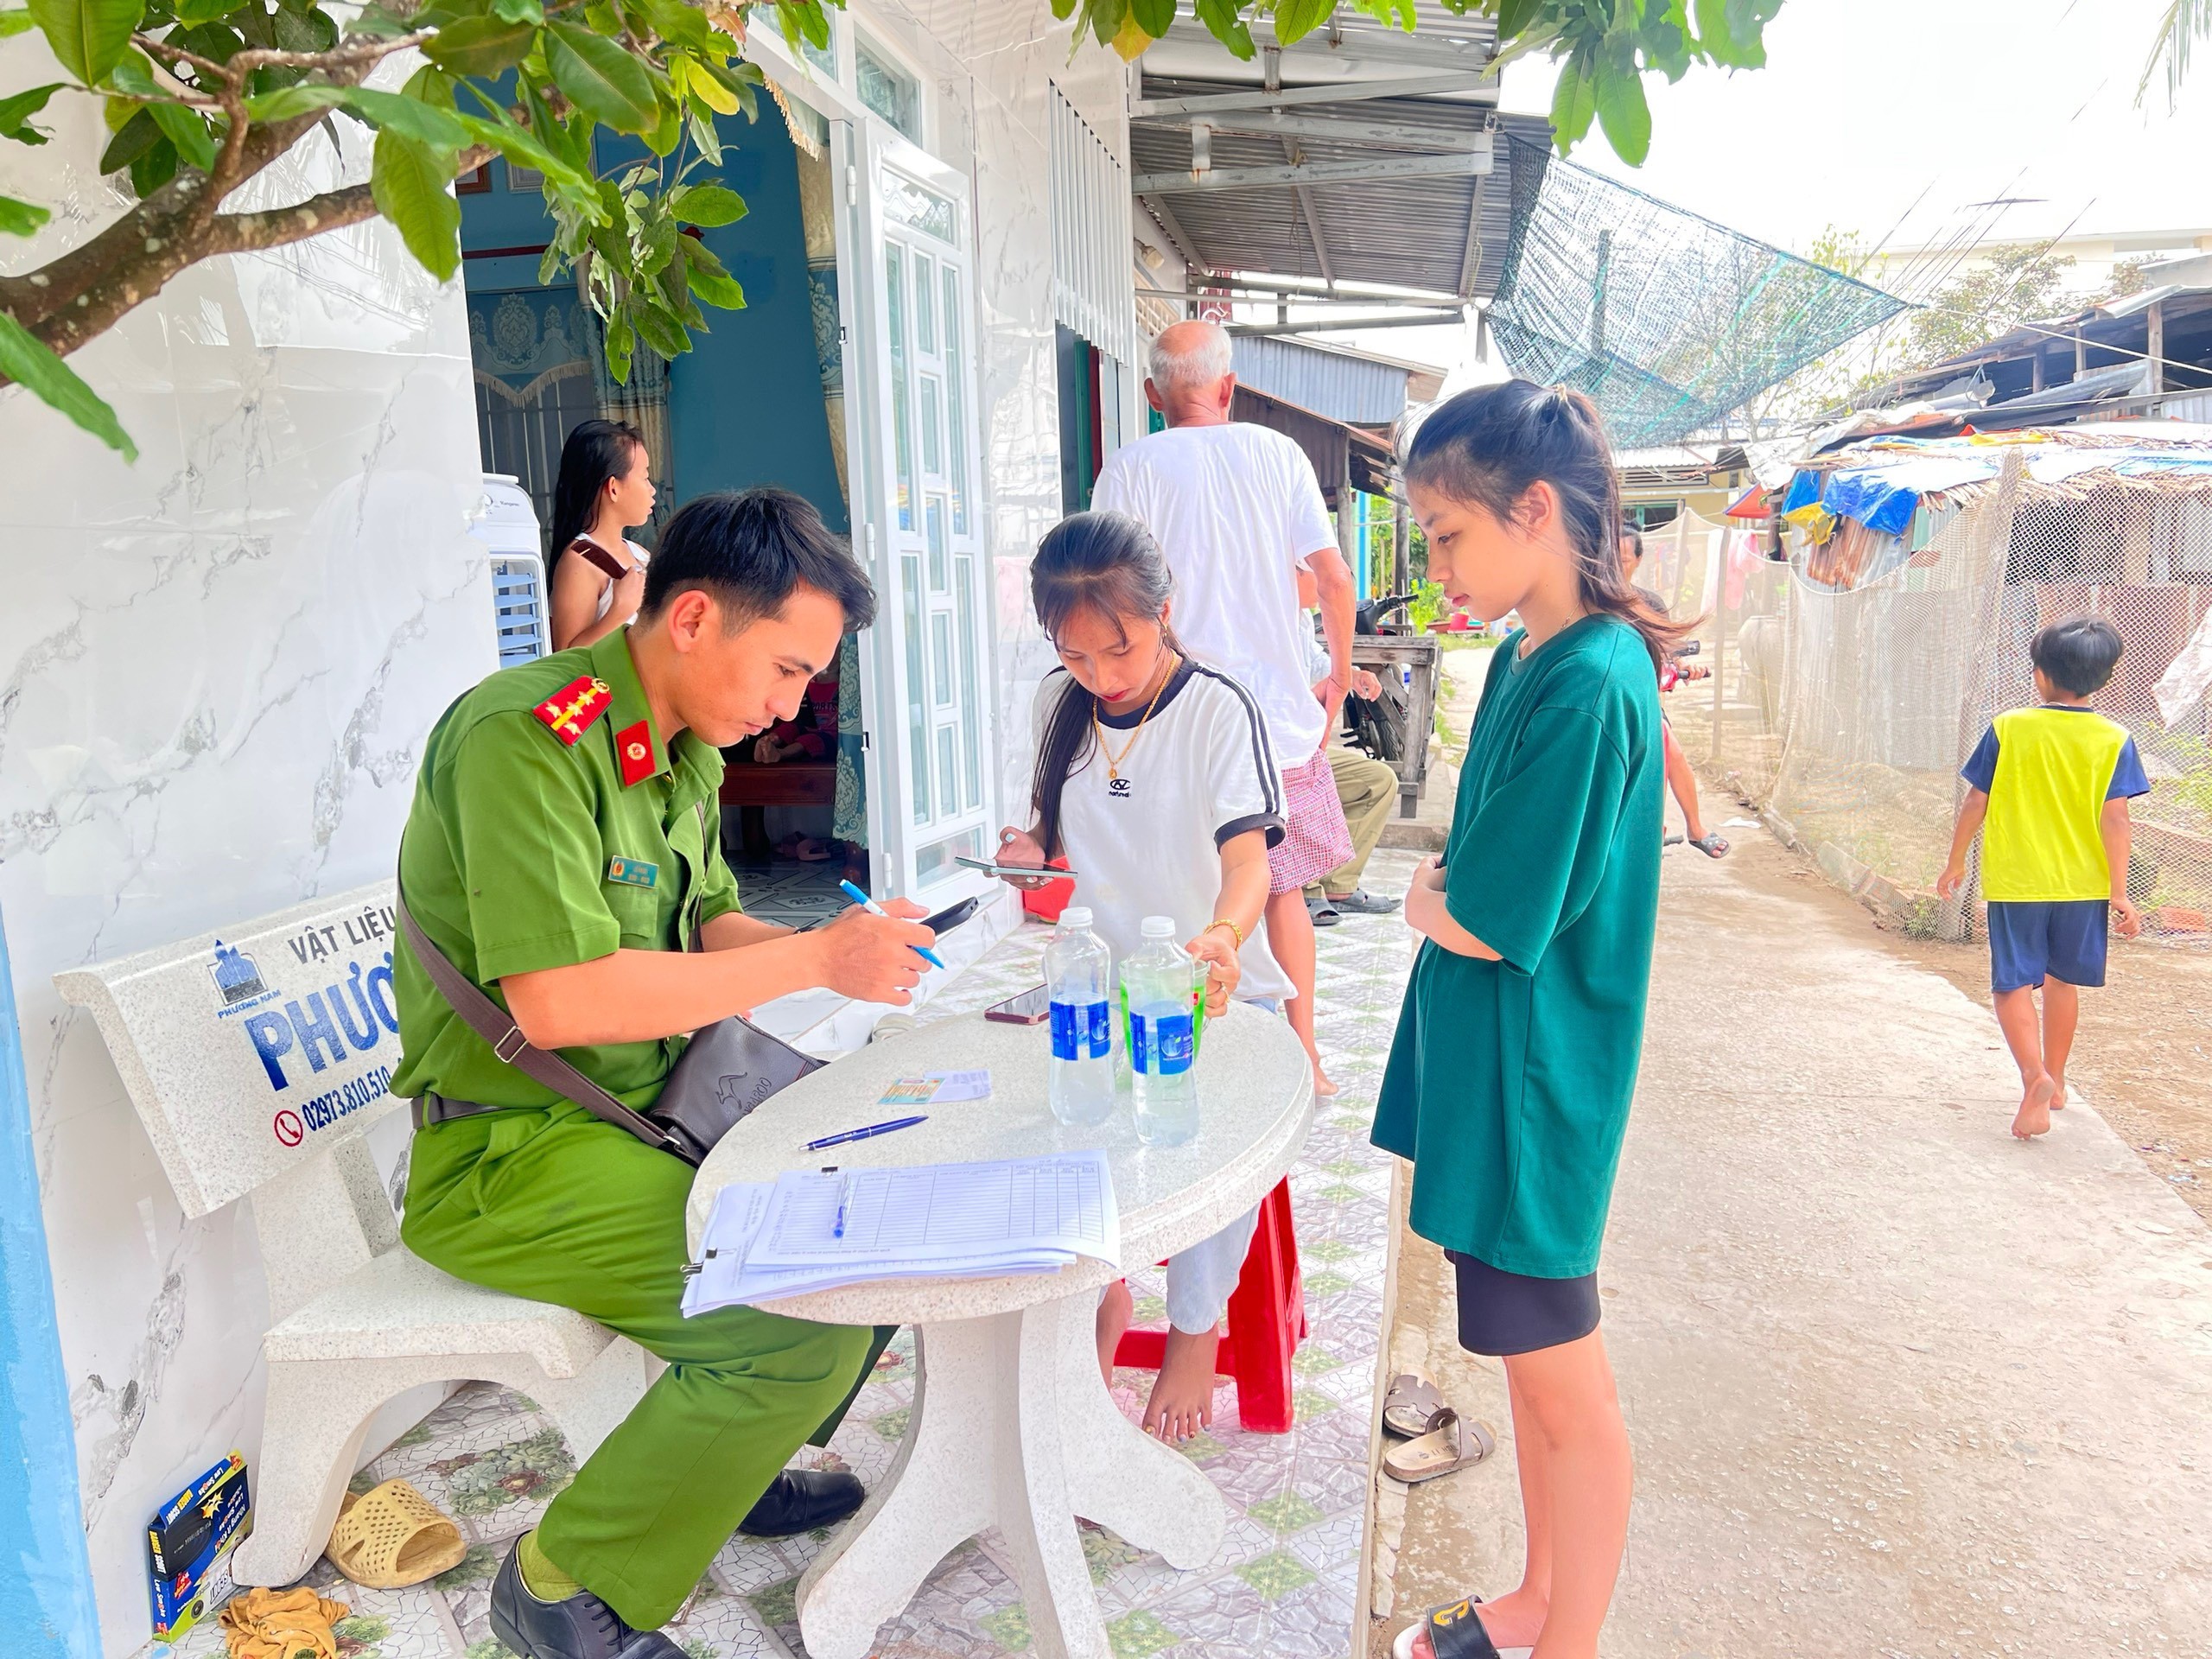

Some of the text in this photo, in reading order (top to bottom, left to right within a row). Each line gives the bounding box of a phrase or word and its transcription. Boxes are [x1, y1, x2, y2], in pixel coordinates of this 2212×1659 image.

[288, 906, 397, 964] VẬT LIỆU
[217, 989, 282, 1019] PHƯƠNG NAM
[302, 1065, 391, 1132] 02973.810.510
